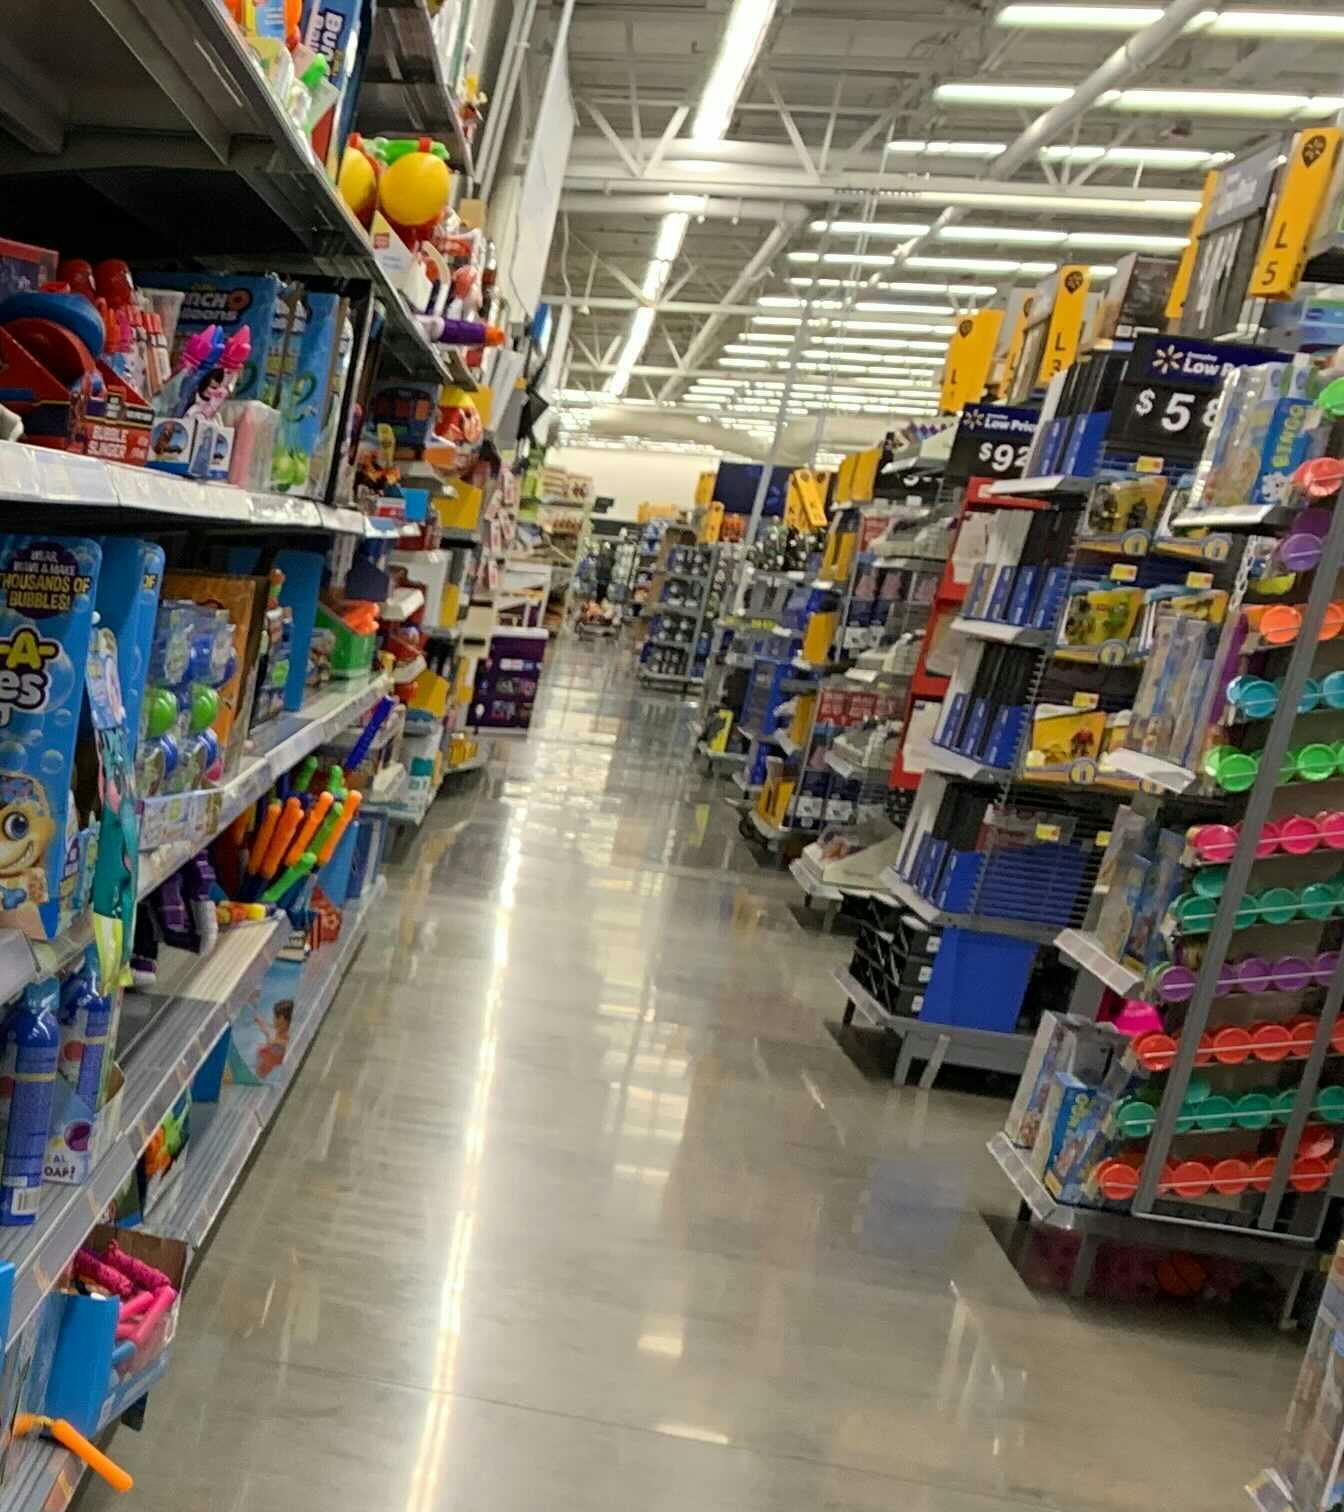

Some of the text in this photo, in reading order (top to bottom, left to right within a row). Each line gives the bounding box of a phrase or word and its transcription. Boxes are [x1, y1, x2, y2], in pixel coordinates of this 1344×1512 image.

[1183, 358, 1219, 376] Low
[984, 417, 1010, 430] Low
[1273, 404, 1305, 467] BINGO
[73, 576, 90, 593] OF
[9, 590, 71, 611] BUBBLES!
[44, 1161, 75, 1178] OAP!
